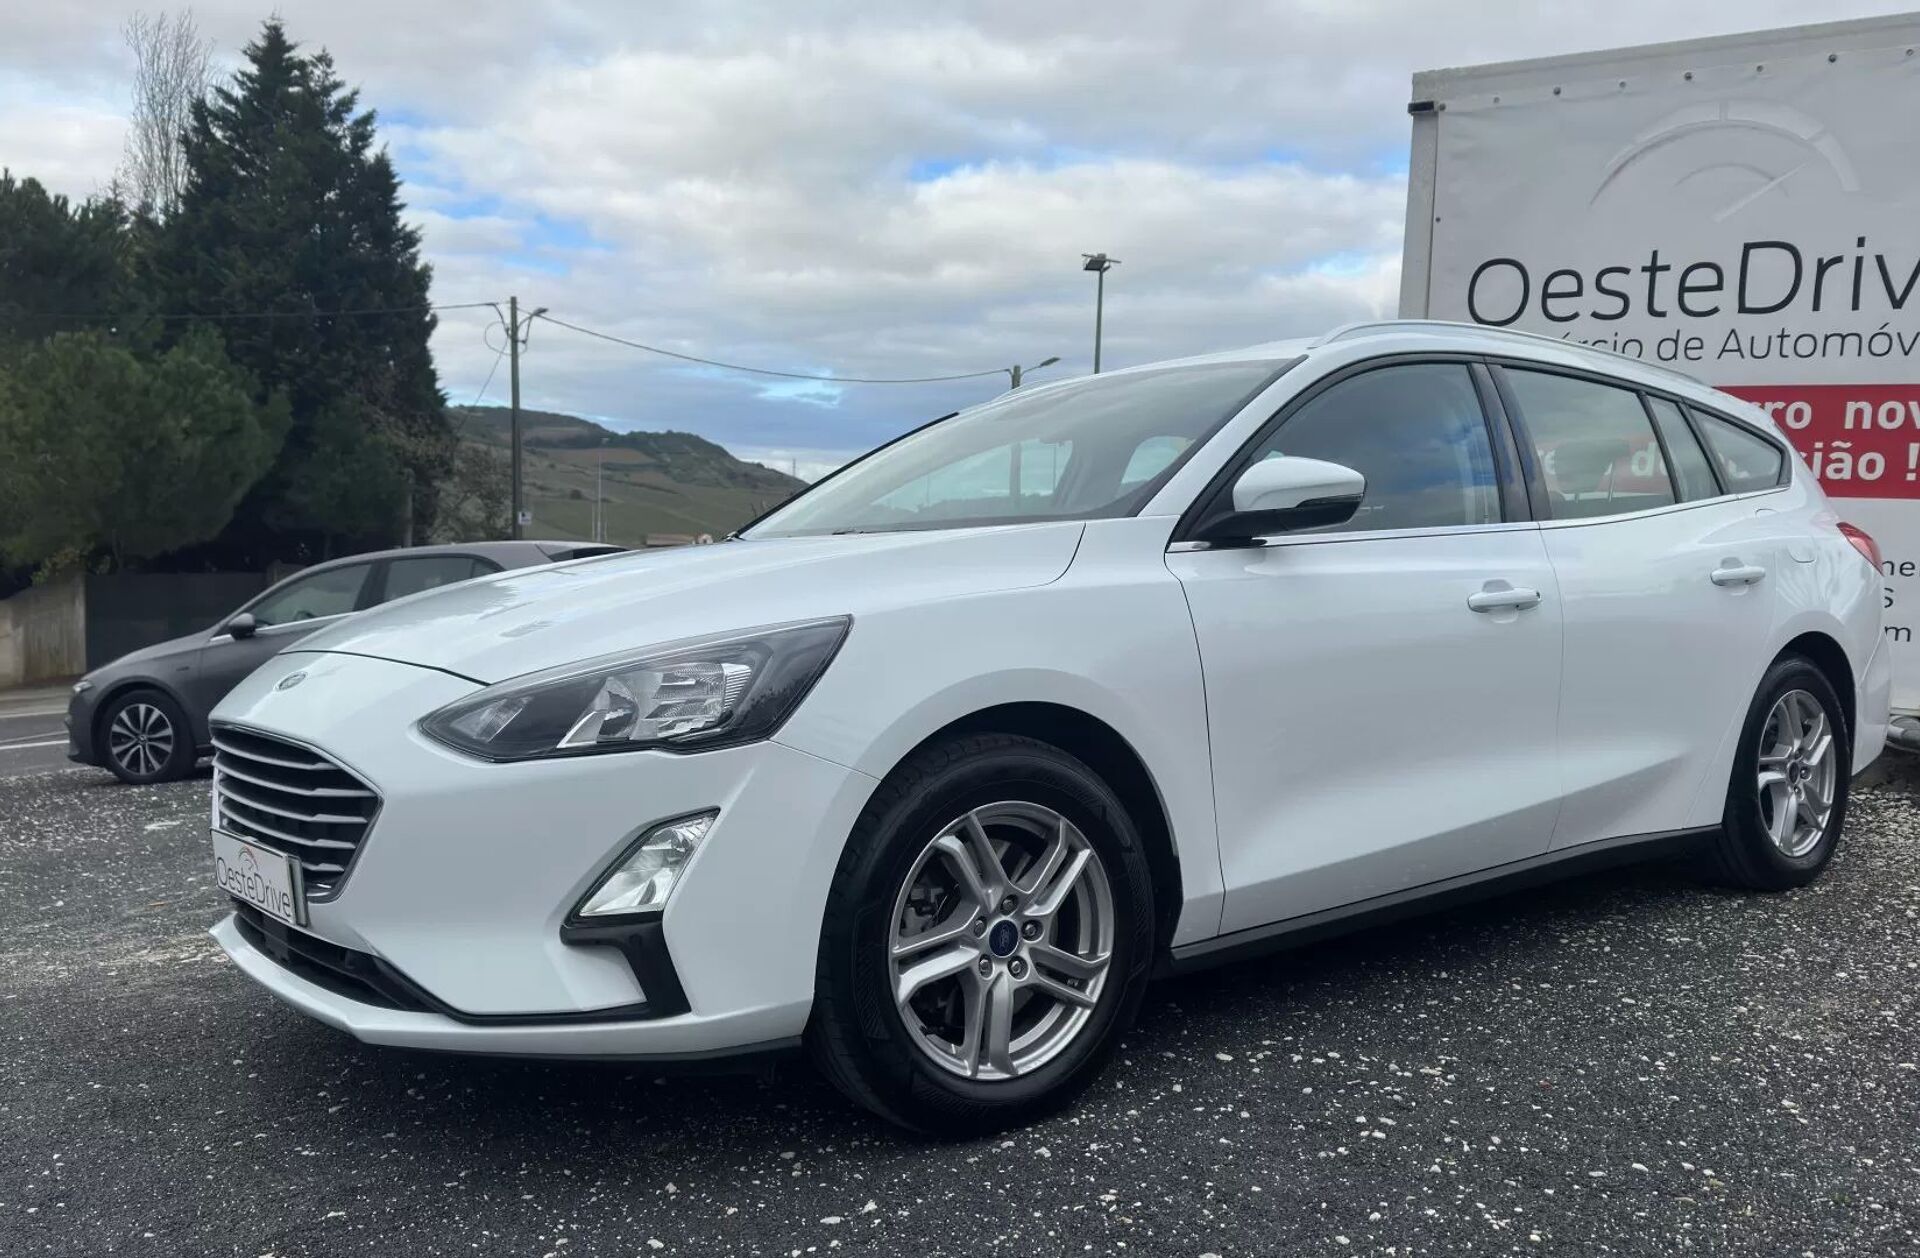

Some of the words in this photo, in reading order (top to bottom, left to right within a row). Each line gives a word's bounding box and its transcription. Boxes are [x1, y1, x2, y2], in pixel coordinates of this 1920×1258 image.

[1657, 329, 1704, 361] de
[1717, 322, 1920, 361] Automóv
[1800, 440, 1886, 481] ião
[216, 856, 292, 918] OesteDrive
